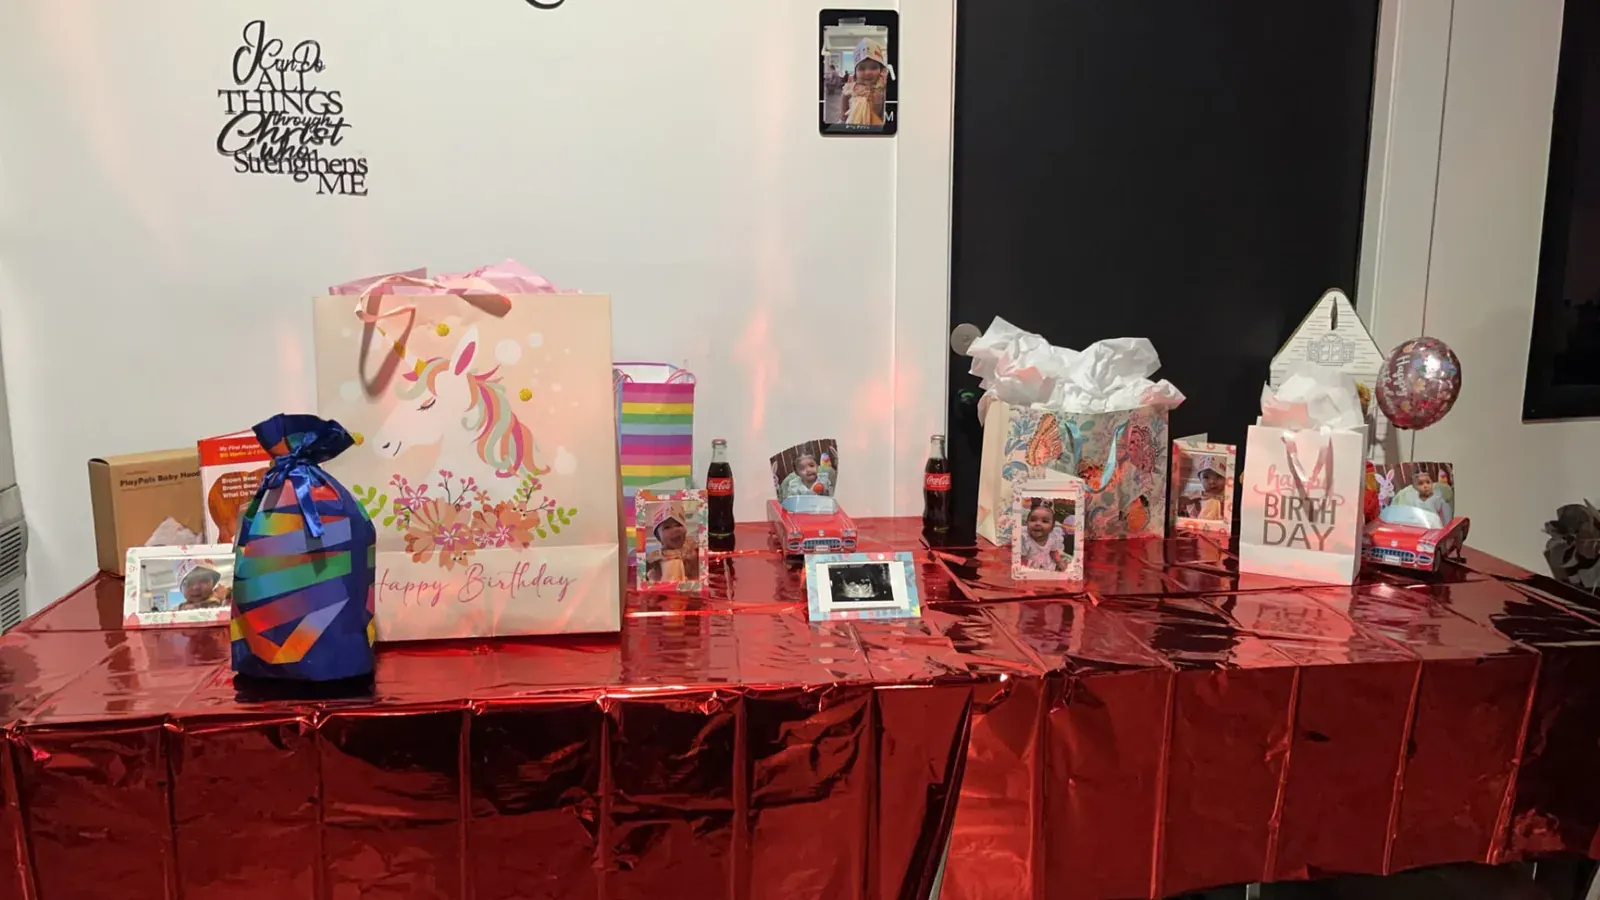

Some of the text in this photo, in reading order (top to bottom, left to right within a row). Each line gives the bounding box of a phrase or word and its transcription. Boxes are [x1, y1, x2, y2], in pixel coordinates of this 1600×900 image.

[258, 39, 297, 71] Can
[292, 40, 324, 73] Do
[253, 68, 317, 93] ALL
[217, 89, 343, 115] THINGS
[217, 111, 352, 157] Christ
[269, 111, 332, 134] through
[260, 133, 310, 163] who
[234, 149, 369, 183] Strengthens
[316, 171, 368, 196] ME
[1393, 354, 1411, 398] Happy
[120, 476, 156, 487] PlayPals
[158, 474, 178, 482] Baby
[222, 491, 239, 499] What
[1264, 493, 1337, 525] BIRTH
[1263, 520, 1335, 551] DAY
[457, 561, 578, 602] Birthday
